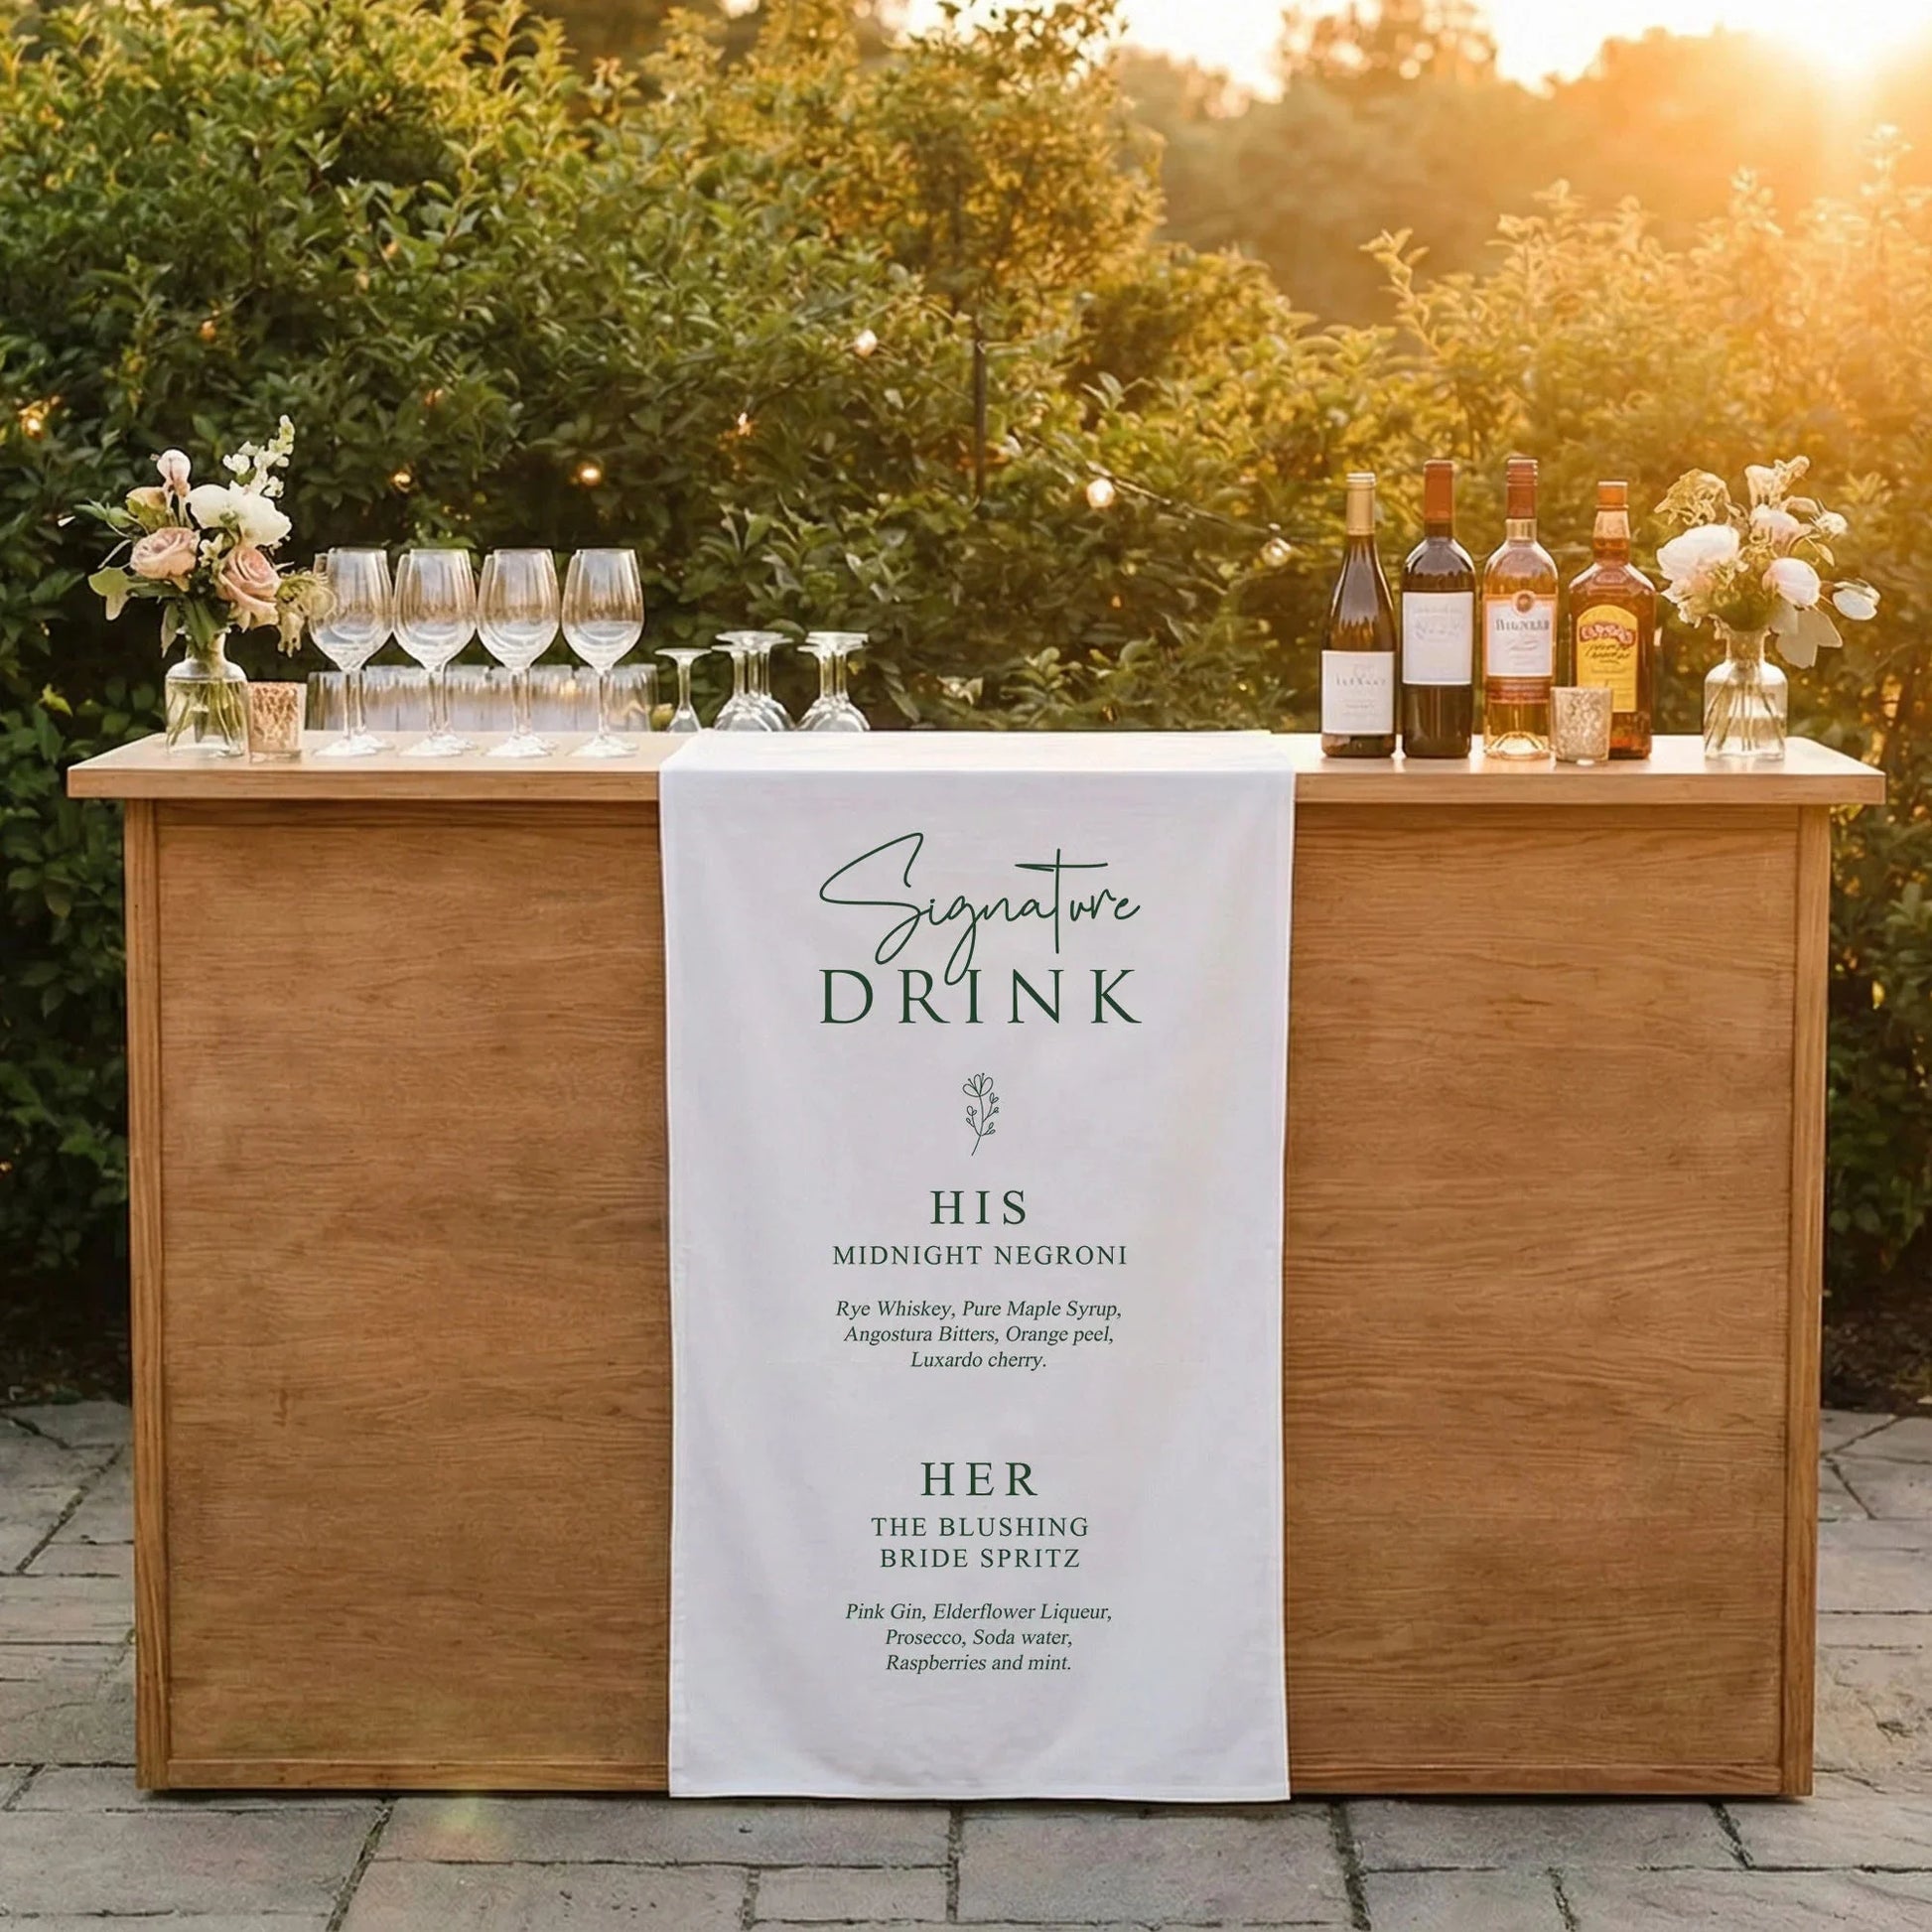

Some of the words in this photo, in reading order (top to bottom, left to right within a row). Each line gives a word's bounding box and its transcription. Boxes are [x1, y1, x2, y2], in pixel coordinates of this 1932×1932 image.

[819, 833, 1141, 986] Signature
[819, 969, 1142, 1024] DRINK
[930, 1190, 1026, 1225] HIS
[833, 1245, 982, 1265] MIDNIGHT
[994, 1245, 1126, 1265] NEGRONI
[836, 1301, 870, 1320] Rye
[878, 1301, 955, 1320] Whiskey,
[962, 1301, 1001, 1316] Pure
[1007, 1301, 1061, 1320] Maple
[1066, 1301, 1121, 1320] Syrup,
[844, 1326, 932, 1346] Angostura
[938, 1325, 999, 1344] Bitters,
[1007, 1325, 1068, 1346] Orange
[1072, 1325, 1113, 1346] peel,
[910, 1351, 983, 1367] Luxardo
[988, 1351, 1045, 1371] cherry.
[920, 1462, 1038, 1496] HER
[871, 1517, 926, 1536] THE
[939, 1517, 1088, 1537] BLUSHING
[881, 1549, 968, 1568] BRIDE
[981, 1549, 1079, 1568] SPRITZ
[846, 1603, 885, 1619] Pink
[891, 1603, 925, 1622] Gin,
[933, 1603, 1035, 1619] Elderflower
[1039, 1603, 1111, 1623] Liqueur,
[886, 1629, 966, 1648] Prosecco,
[973, 1628, 1015, 1645] Soda
[1022, 1631, 1072, 1648] water,
[886, 1654, 987, 1674] Raspberries
[992, 1654, 1024, 1670] and
[1028, 1654, 1070, 1670] mint.
